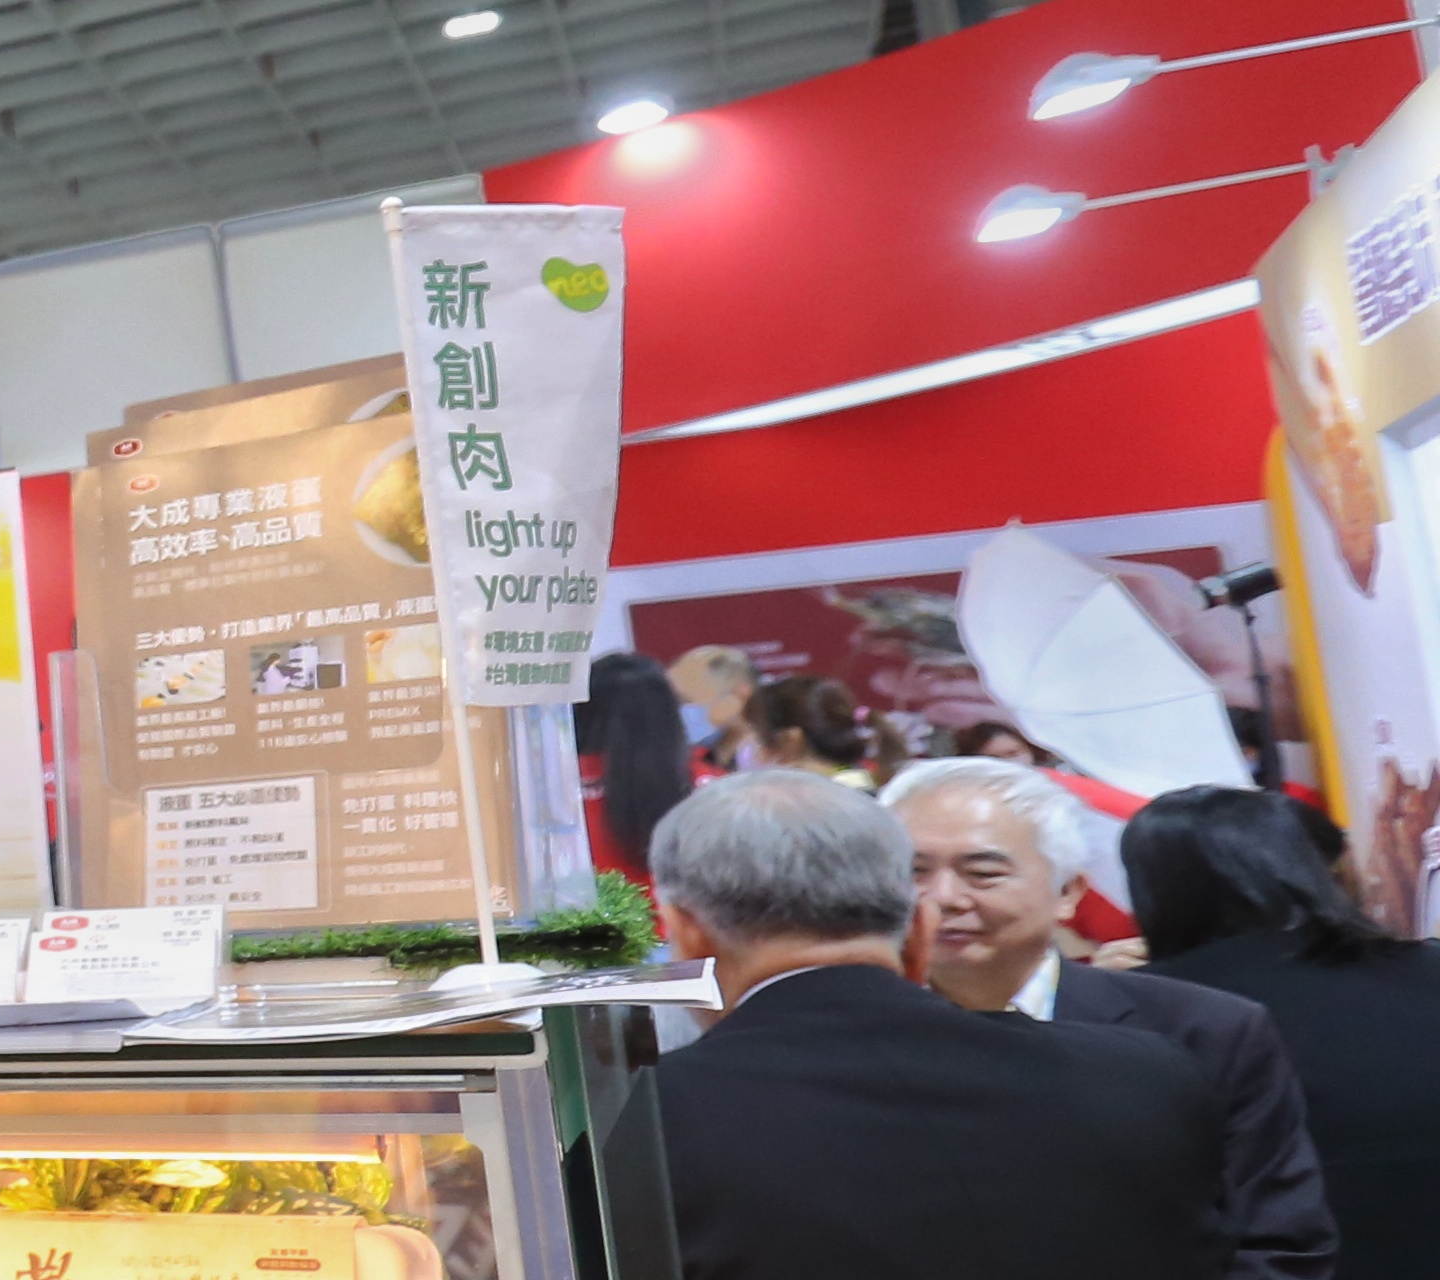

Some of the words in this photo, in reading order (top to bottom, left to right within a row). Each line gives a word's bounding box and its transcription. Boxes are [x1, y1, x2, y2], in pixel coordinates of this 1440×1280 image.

[546, 270, 610, 298] neo
[422, 258, 514, 492] 新創肉
[129, 476, 323, 533] 大成專業液蛋
[130, 510, 324, 567] 高效率、高品質
[465, 510, 545, 558] light
[550, 520, 578, 558] up
[475, 574, 544, 613] your
[546, 565, 598, 614] plate
